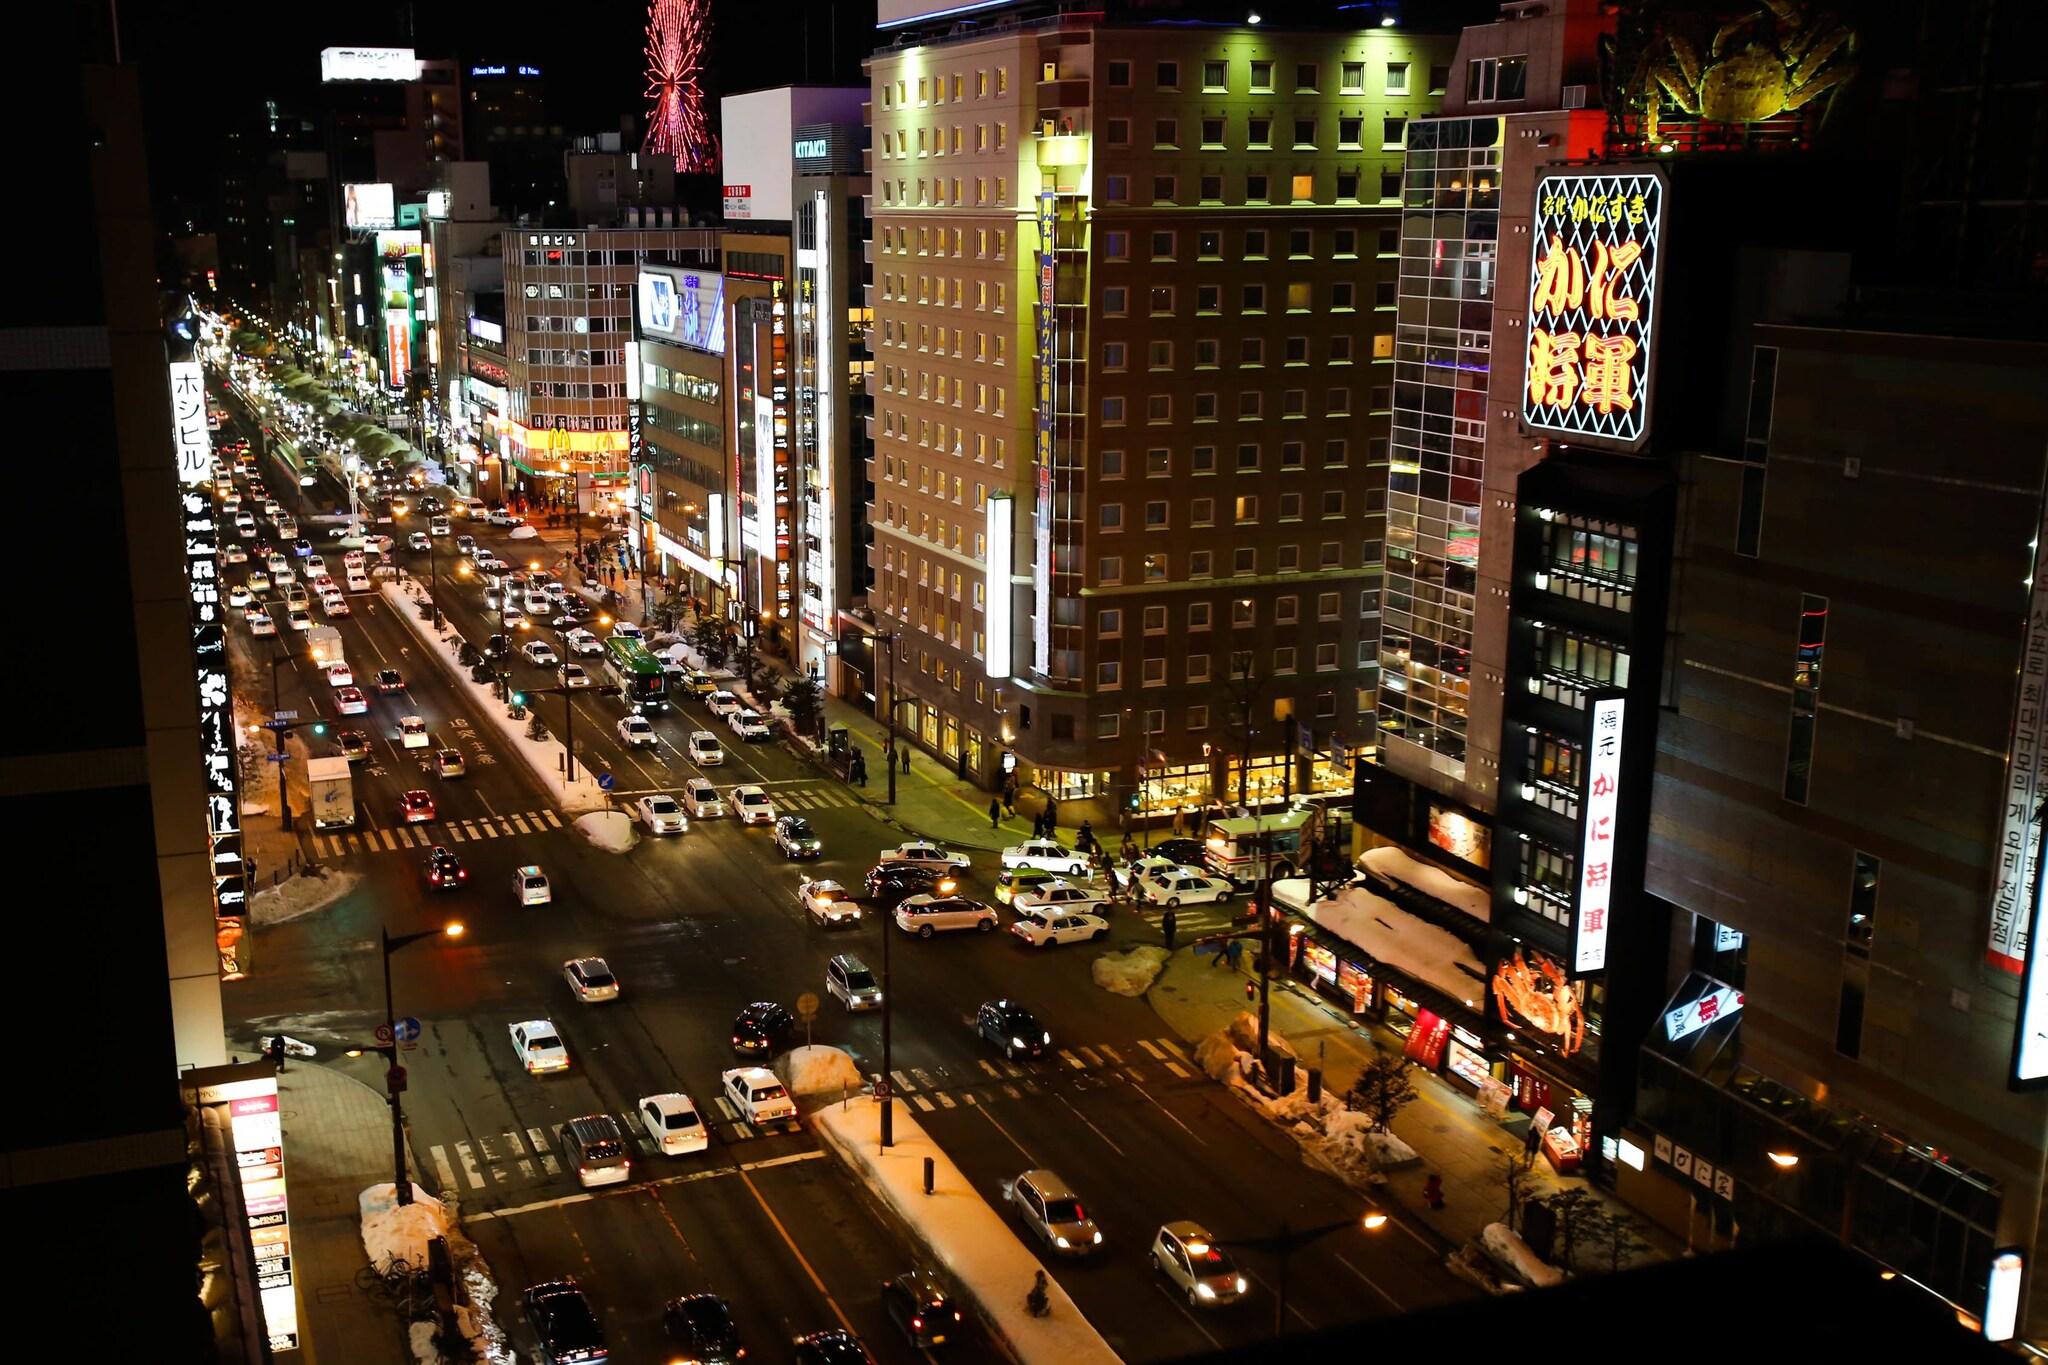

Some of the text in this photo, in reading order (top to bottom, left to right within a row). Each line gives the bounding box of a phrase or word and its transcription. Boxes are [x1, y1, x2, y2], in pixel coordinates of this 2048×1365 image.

[795, 140, 827, 158] KITAKO
[1533, 233, 1642, 321] かに
[1528, 326, 1636, 415] 将軍
[2008, 802, 2026, 825] 게
[2003, 830, 2022, 873] 요리
